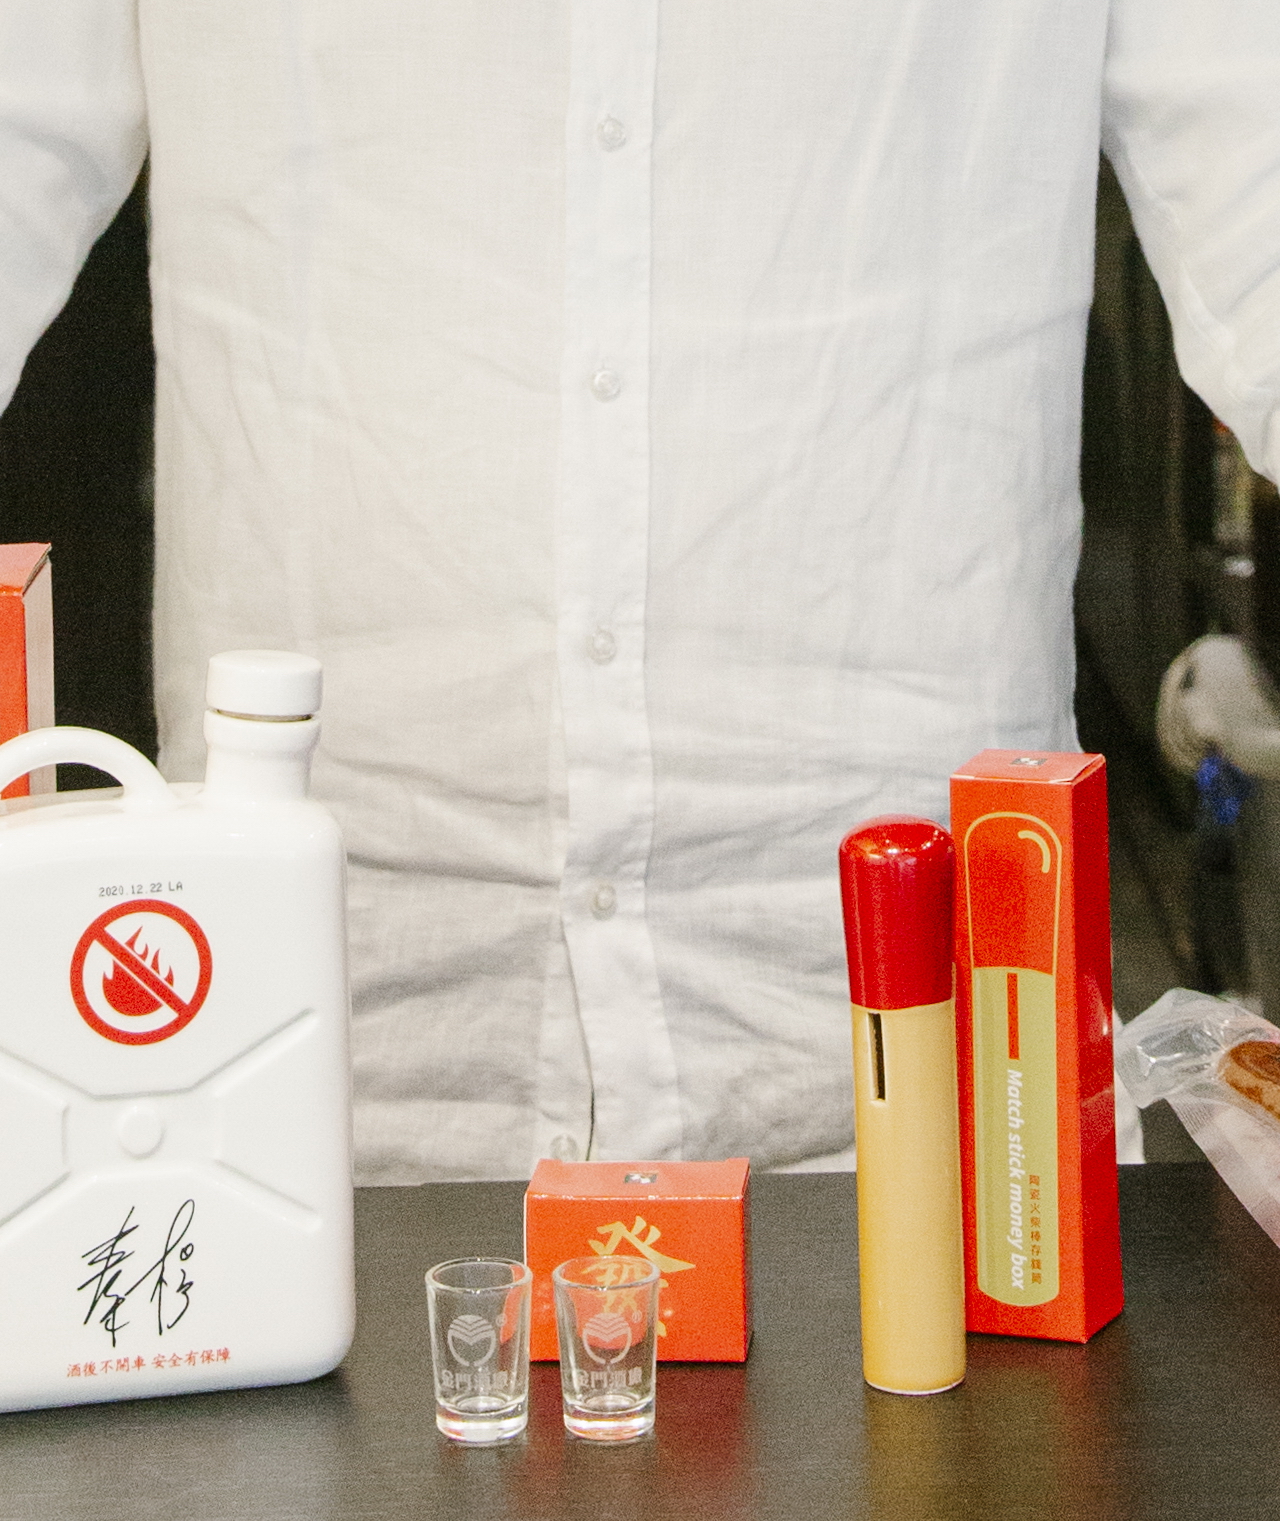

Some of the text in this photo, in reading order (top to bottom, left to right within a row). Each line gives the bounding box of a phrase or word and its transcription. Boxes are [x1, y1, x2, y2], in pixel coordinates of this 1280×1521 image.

[168, 881, 183, 892] LA
[1007, 1069, 1028, 1290] Match stick money box
[67, 1347, 231, 1377] 酒後不開車 安全有保障
